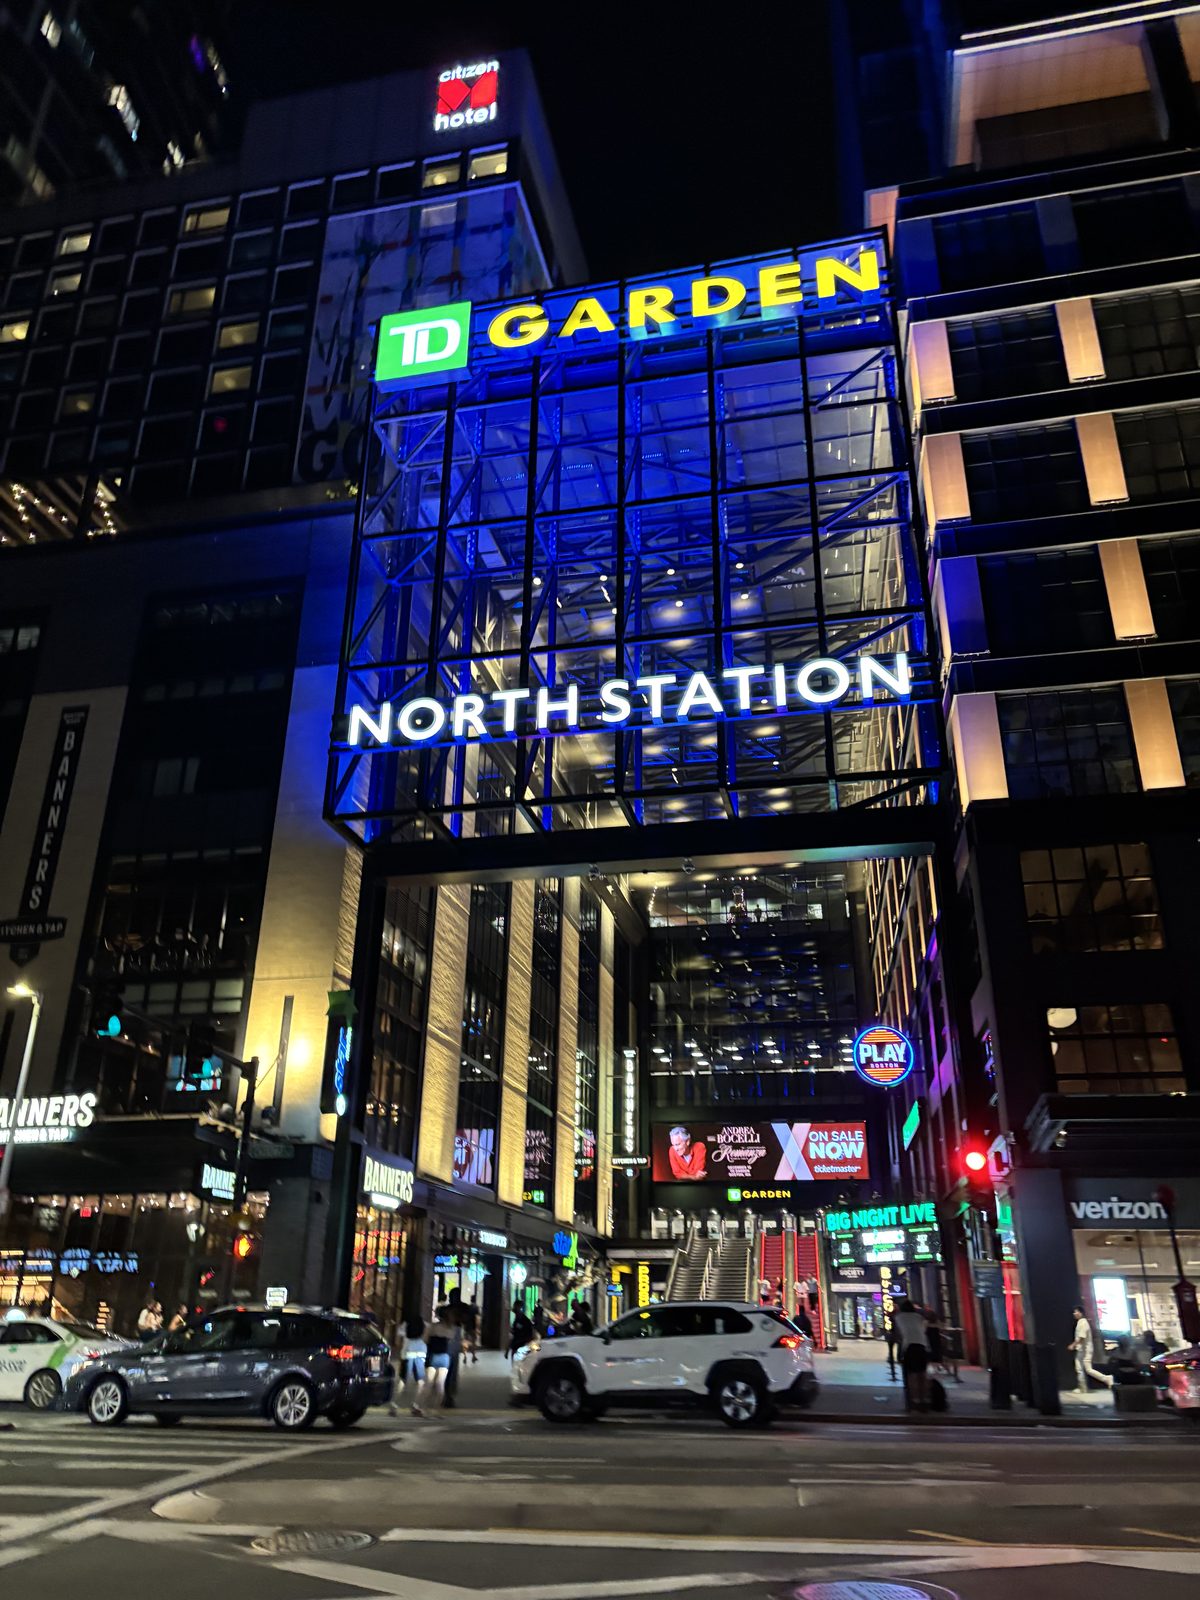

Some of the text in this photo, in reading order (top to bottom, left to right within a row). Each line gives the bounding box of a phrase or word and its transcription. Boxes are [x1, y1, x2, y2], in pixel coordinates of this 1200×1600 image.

[439, 60, 499, 83] citizen
[434, 101, 497, 131] hotel
[389, 250, 880, 367] TD GARDEN
[349, 652, 911, 745] NORTH STATION
[28, 731, 76, 910] BANNERS
[859, 1042, 906, 1064] PLAY
[625, 1059, 635, 1153] BANNERS
[717, 1133, 760, 1144] BOCELLI
[721, 1126, 756, 1135] ANDREA
[808, 1130, 864, 1142] ON SALE
[808, 1141, 865, 1160] NOW
[201, 1163, 236, 1193] BANNE
[363, 1155, 414, 1204] BANNERS
[742, 1190, 791, 1199] GARDEN
[1070, 1196, 1168, 1219] verizon
[826, 1202, 937, 1232] BIG NIGHT LIVE
